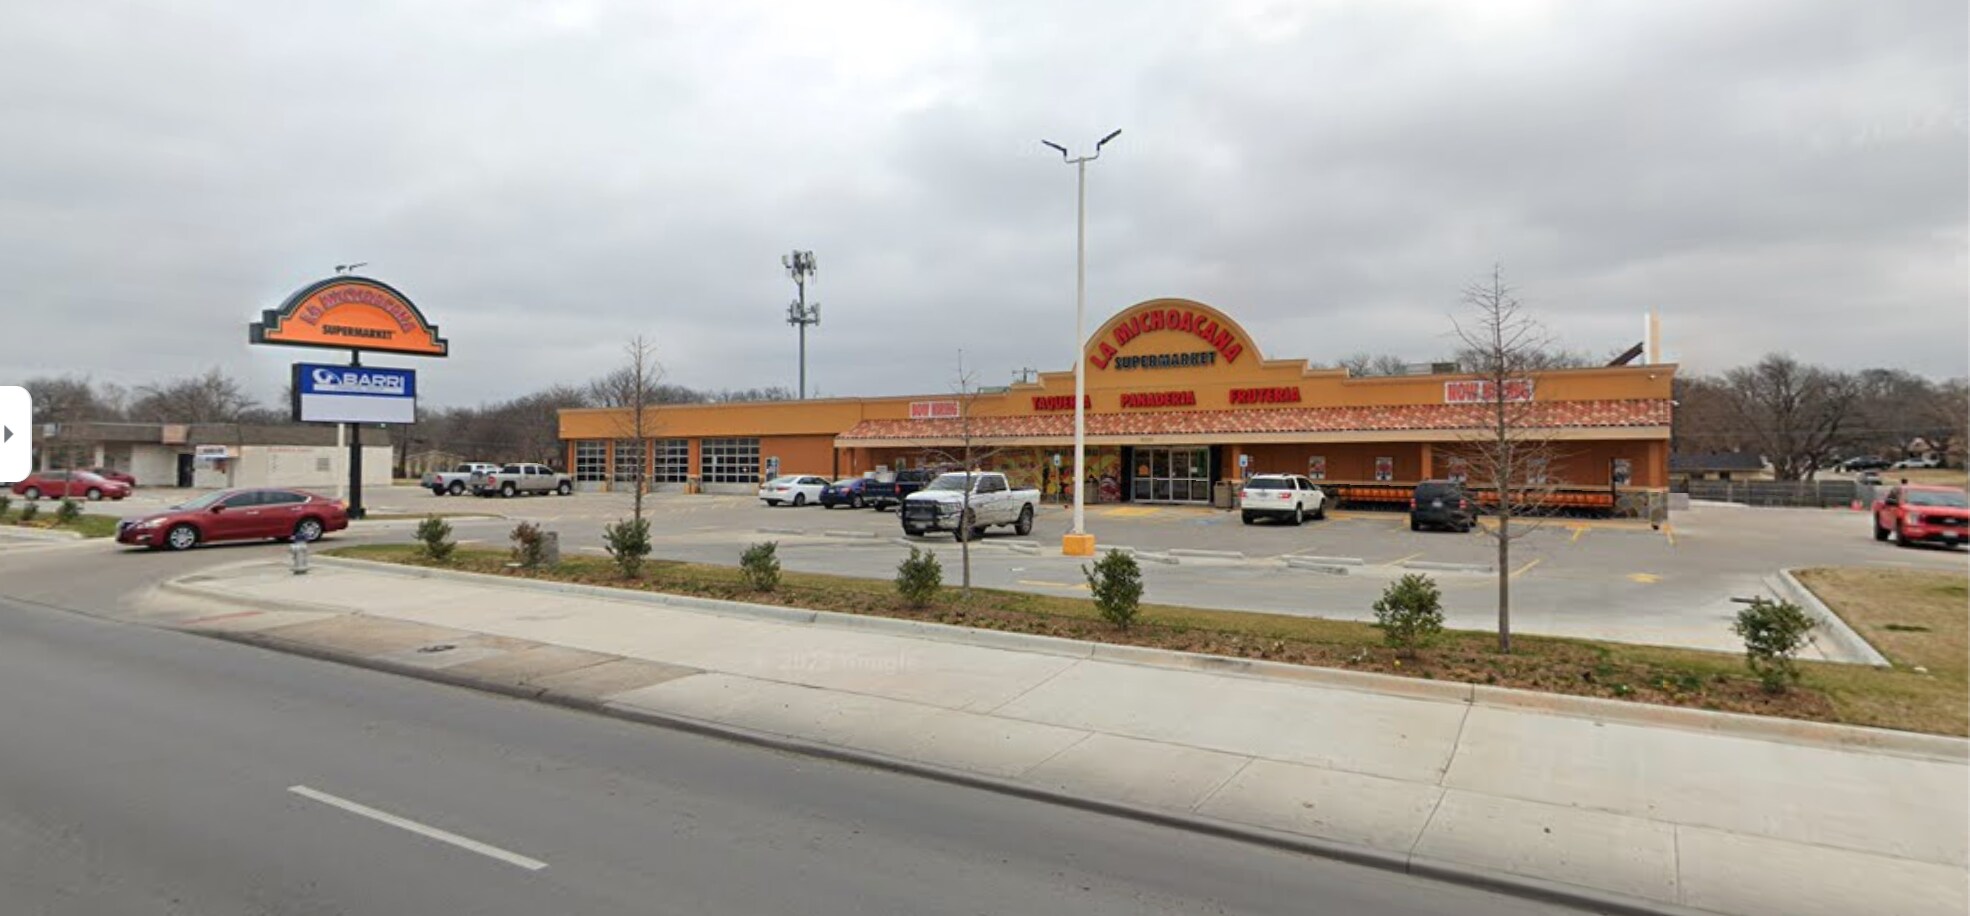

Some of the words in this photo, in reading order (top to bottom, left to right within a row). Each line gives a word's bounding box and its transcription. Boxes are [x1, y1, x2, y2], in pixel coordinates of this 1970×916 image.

[322, 324, 392, 340] SUPERMARKET
[1089, 341, 1118, 370] LA
[1113, 308, 1243, 364] MICHOACANA
[1114, 351, 1218, 370] SUPERMARKET
[342, 372, 406, 389] BARRI
[1031, 394, 1092, 411] TAQUERA
[1120, 390, 1196, 409] PANADERIA
[1229, 386, 1302, 405] FRUTERIA
[1447, 383, 1478, 401] NOW
